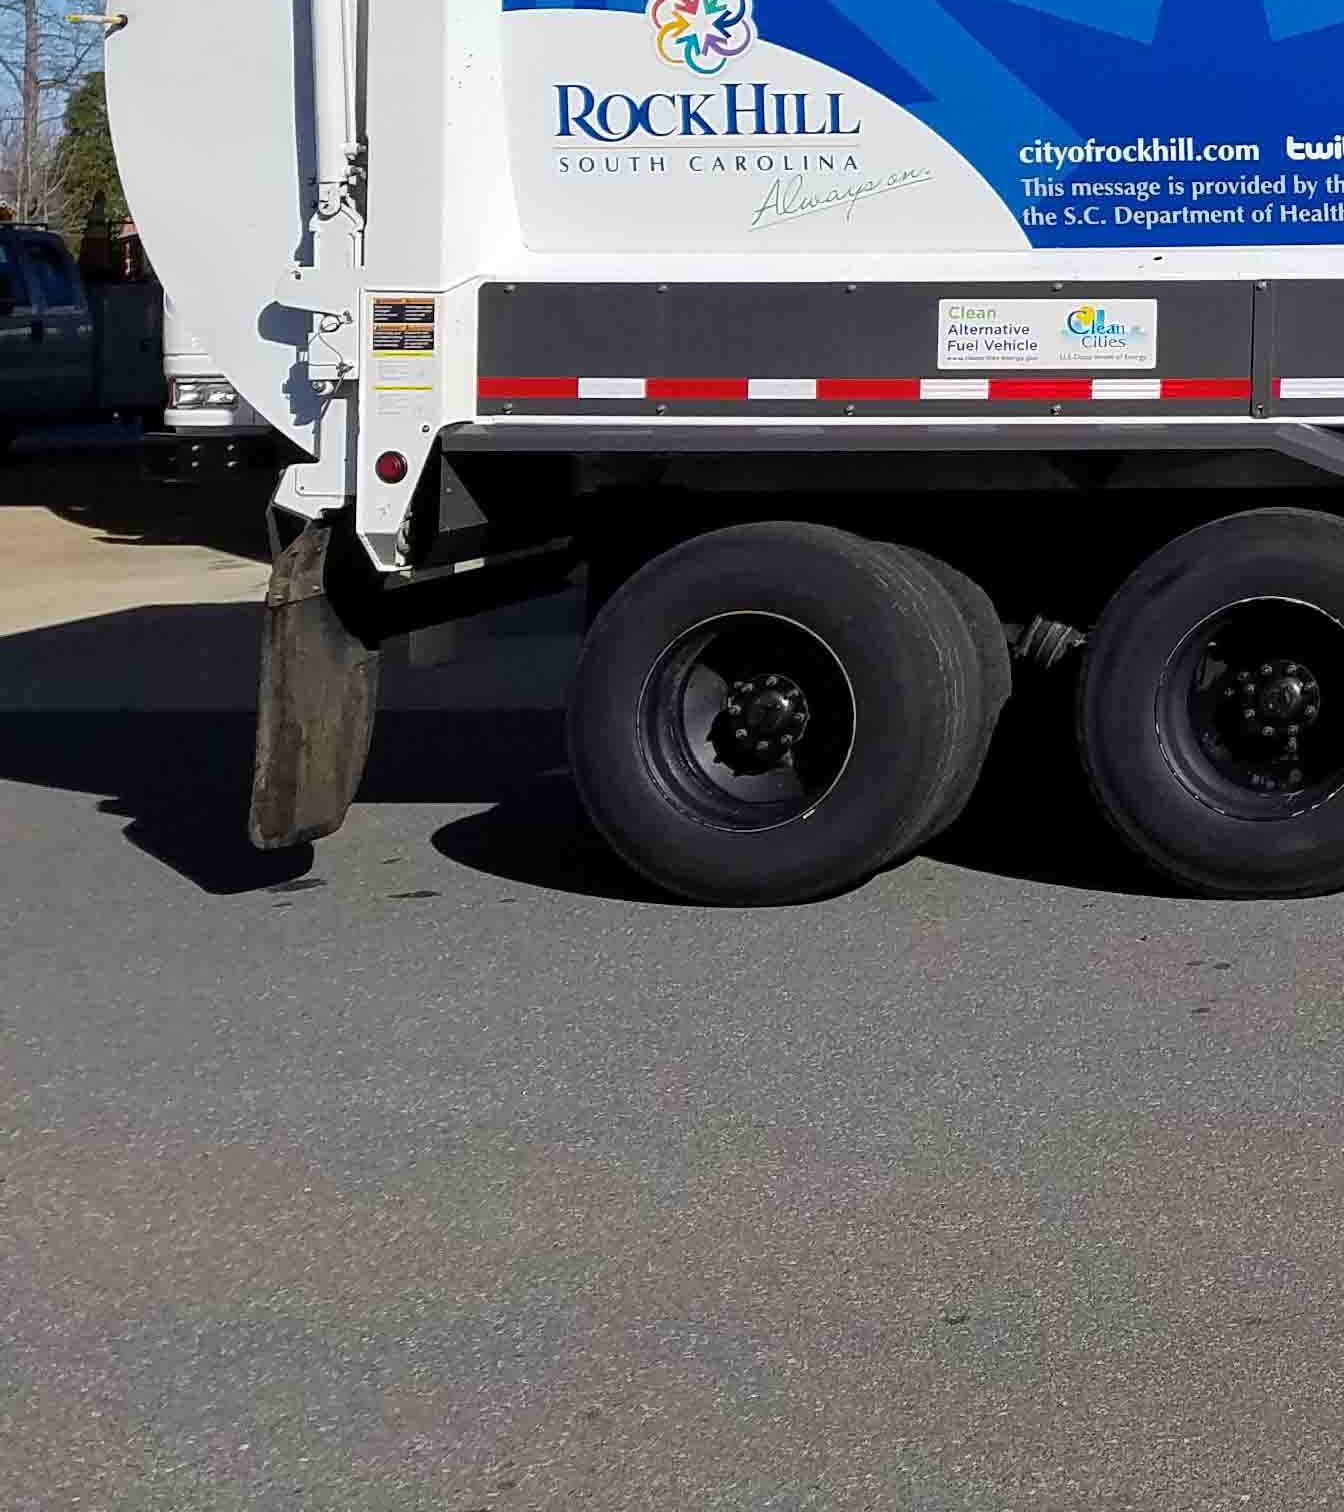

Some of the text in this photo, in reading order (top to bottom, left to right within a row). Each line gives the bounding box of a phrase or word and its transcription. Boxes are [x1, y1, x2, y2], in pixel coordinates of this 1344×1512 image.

[1019, 136, 1260, 171] cityofrockhill.com
[559, 154, 859, 173] SOUTH CAROLINA
[1020, 176, 1065, 197] This
[1071, 180, 1161, 201] message
[1168, 175, 1185, 196] is
[1191, 174, 1286, 201] provided
[1293, 174, 1317, 199] by
[1023, 206, 1057, 226] the
[1064, 206, 1107, 226] S.C.
[1114, 205, 1245, 230] Department
[1250, 203, 1274, 224] of
[948, 306, 997, 320] Clean
[1067, 309, 1126, 336] Clean
[947, 323, 1031, 336] Alternative
[947, 339, 1039, 352] Fuel Vehicle
[1081, 335, 1127, 349] Cities
